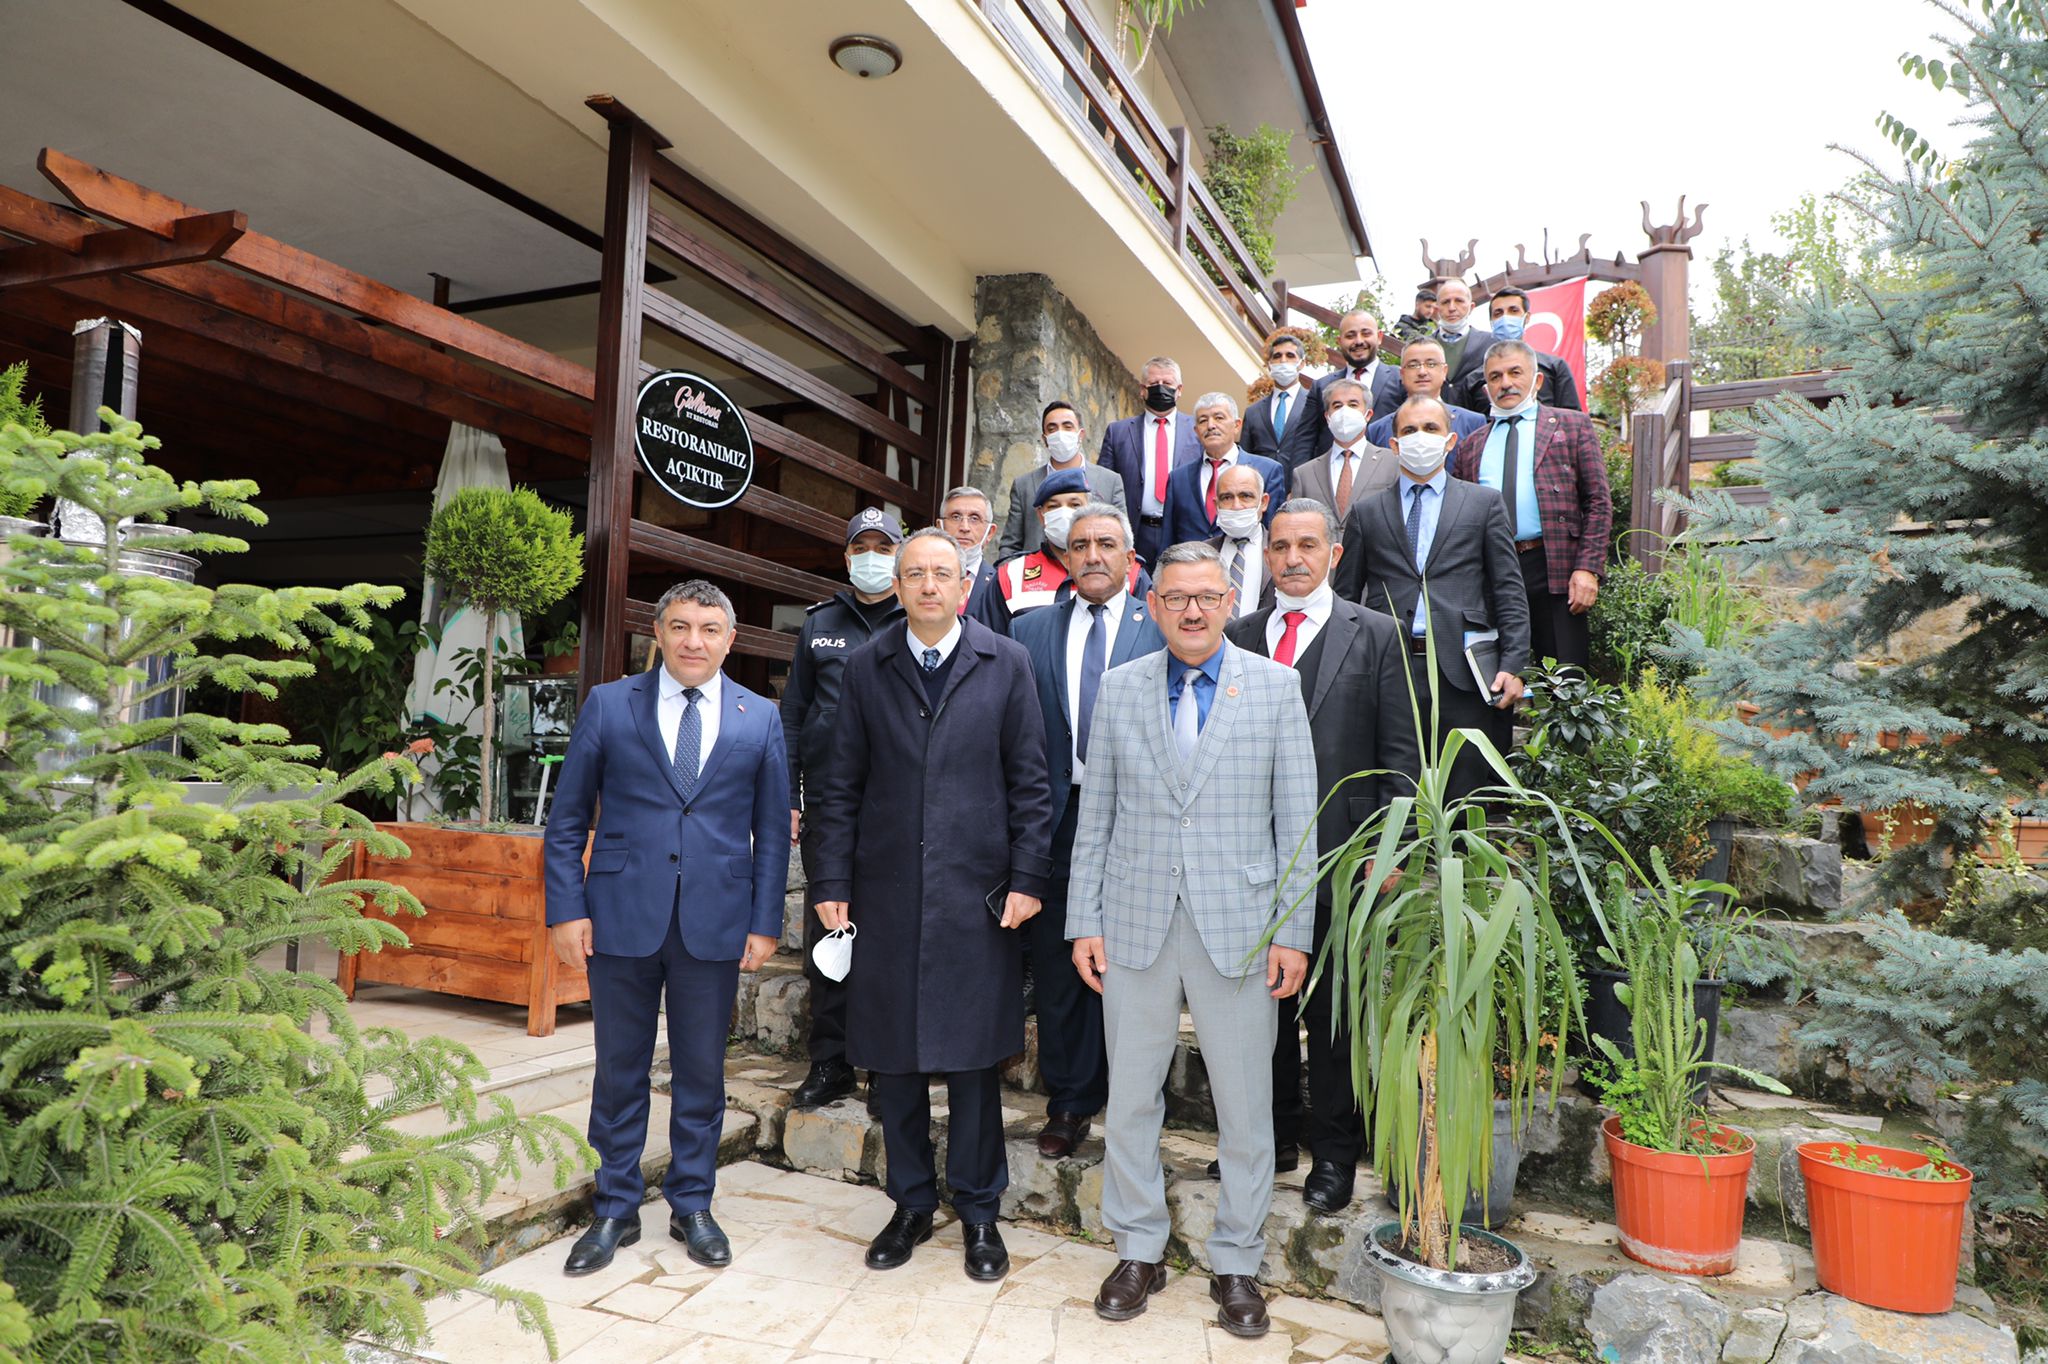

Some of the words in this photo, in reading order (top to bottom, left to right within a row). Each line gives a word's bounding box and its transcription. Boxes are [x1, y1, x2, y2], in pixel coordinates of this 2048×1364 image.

[693, 414, 719, 429] RESTORAN
[642, 416, 747, 469] RESTORANIMIZ
[665, 458, 725, 491] AÇIKTIR
